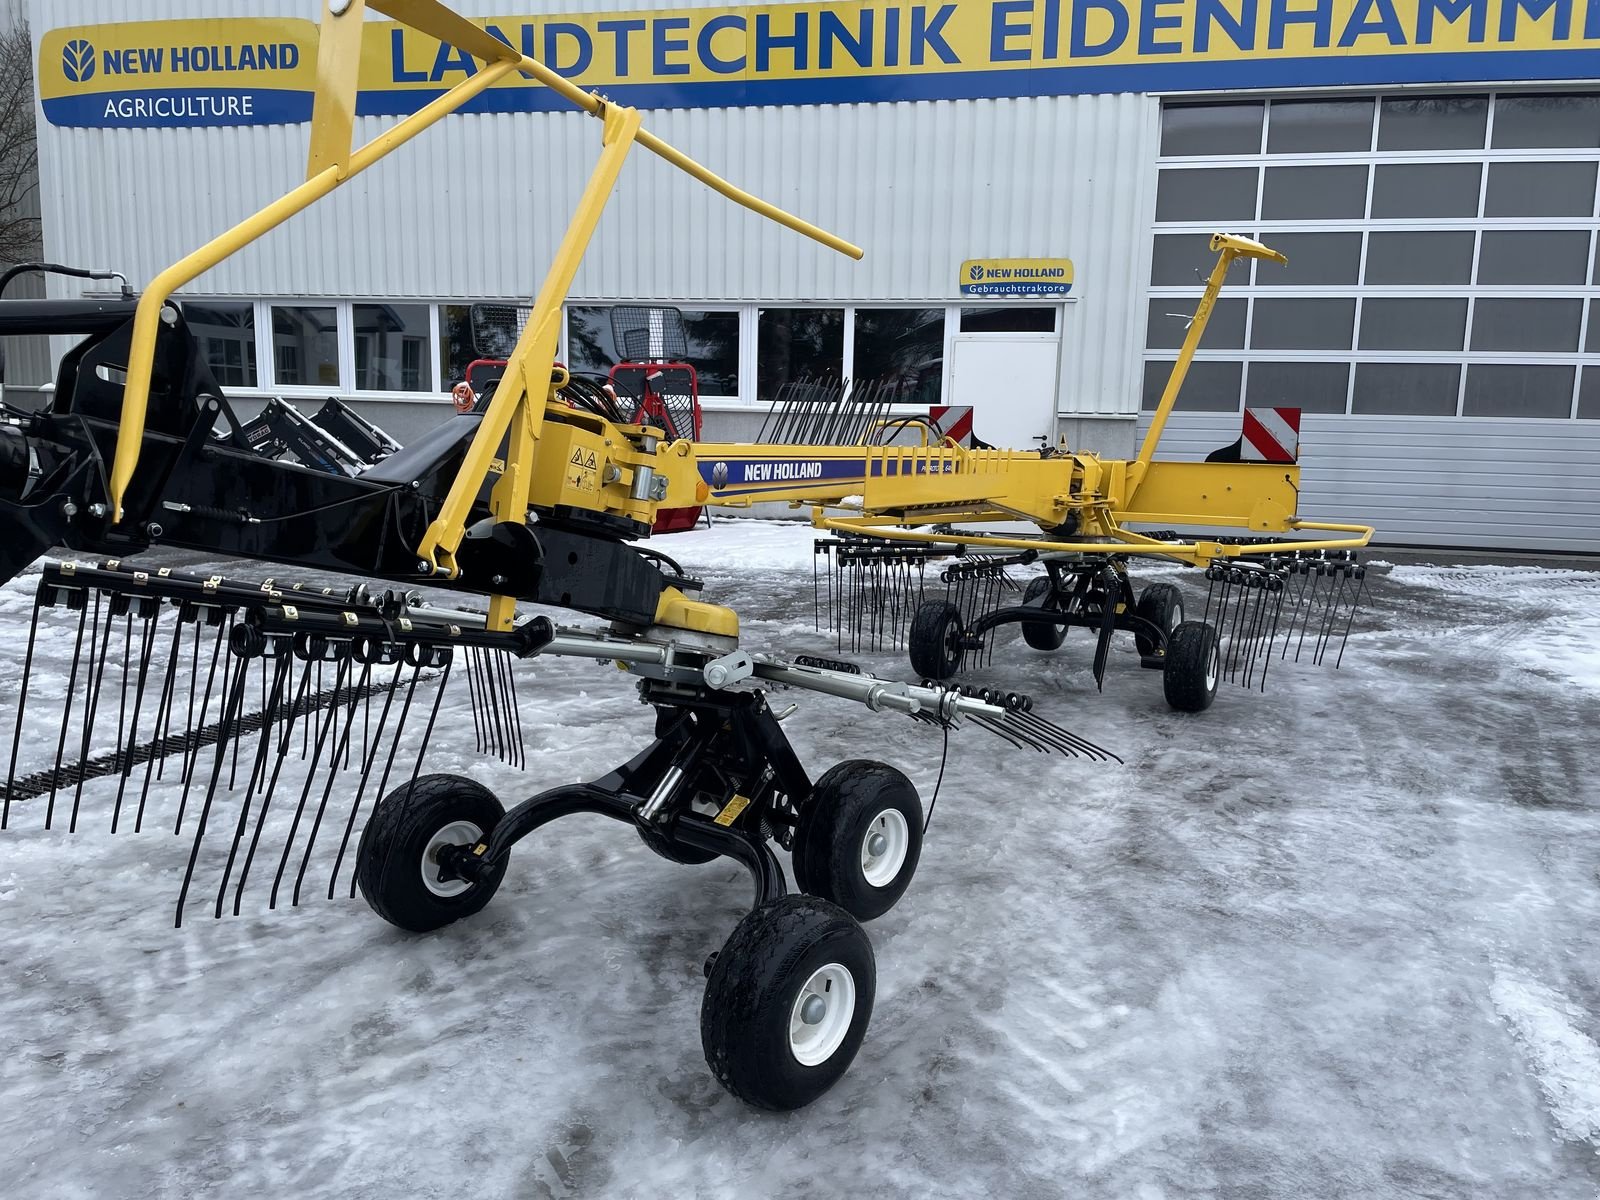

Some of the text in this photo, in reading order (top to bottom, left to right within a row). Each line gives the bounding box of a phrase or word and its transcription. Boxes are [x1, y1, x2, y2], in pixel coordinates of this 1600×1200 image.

[391, 0, 1600, 83] LANDTECHNIK EIDENHAMM
[103, 43, 299, 75] NEW HOLLAND
[103, 95, 253, 118] AGRICULTURE
[986, 267, 1065, 278] NEW HOLLAND
[969, 284, 1065, 294] Gebrauchttraktore
[744, 462, 822, 481] NEW HOLLAND
